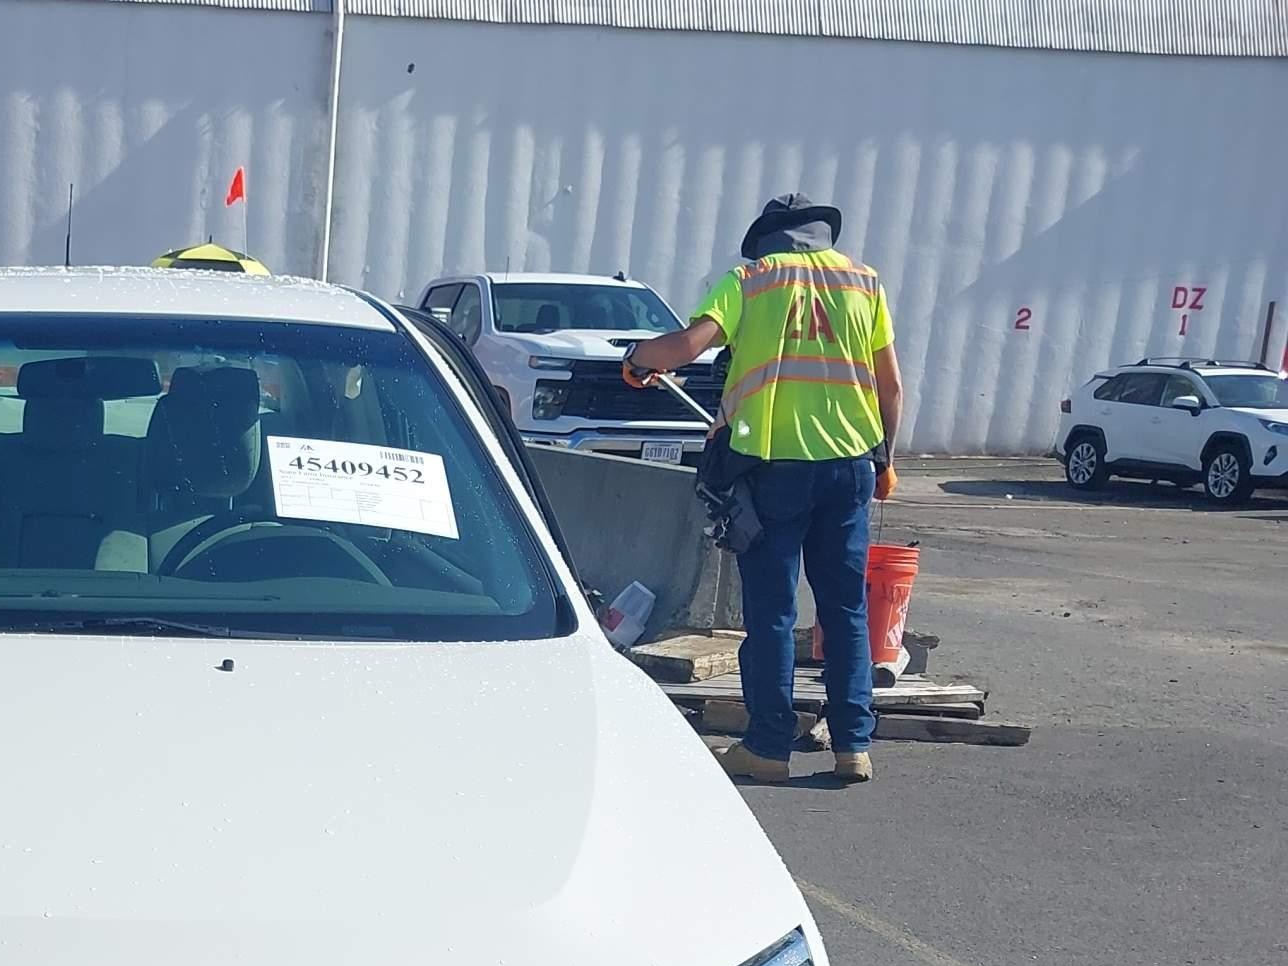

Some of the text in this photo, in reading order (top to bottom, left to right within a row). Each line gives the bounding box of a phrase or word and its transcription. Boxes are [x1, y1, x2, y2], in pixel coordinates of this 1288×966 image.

[1171, 286, 1207, 311] DZ
[1015, 307, 1032, 330] 2
[1178, 314, 1189, 336] 1
[288, 455, 425, 485] 45409452
